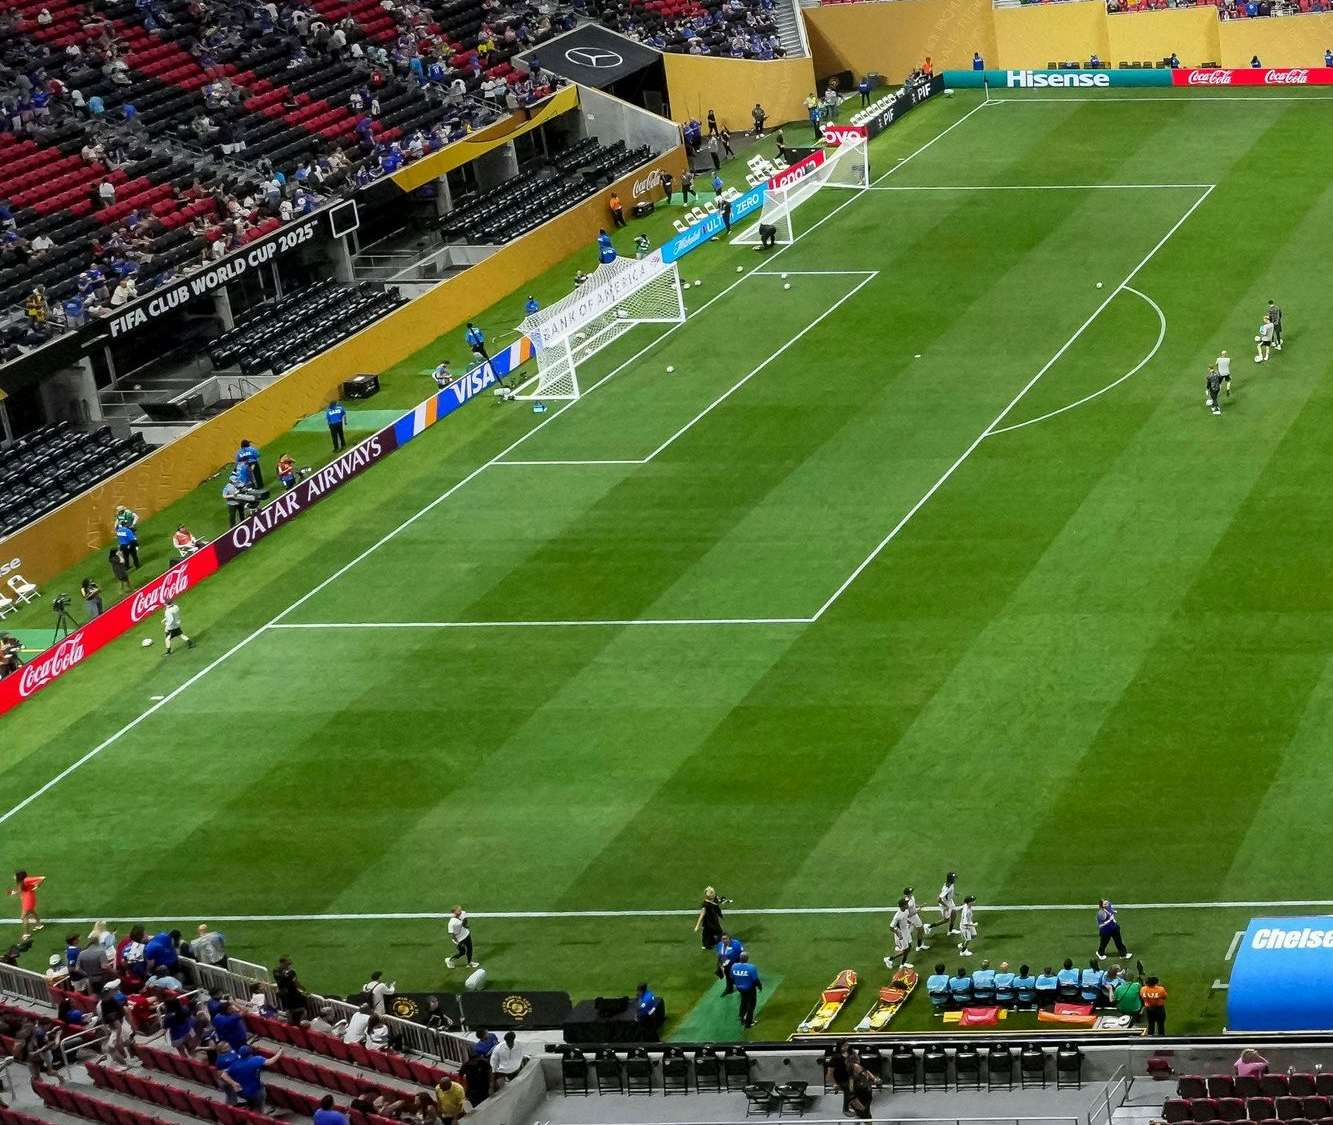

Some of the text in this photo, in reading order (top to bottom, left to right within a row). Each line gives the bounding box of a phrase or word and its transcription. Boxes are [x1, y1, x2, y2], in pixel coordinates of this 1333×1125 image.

[1006, 70, 1110, 88] Hisense
[1188, 69, 1232, 86] Coca-Cola
[1264, 69, 1310, 86] Coca-Cola
[917, 82, 931, 100] PIF
[883, 108, 895, 126] PIF
[736, 192, 760, 213] ZERO
[110, 304, 147, 339] FIFA
[149, 284, 189, 317] CLUB
[190, 256, 246, 302] WORLD
[248, 239, 277, 270] CUP
[449, 362, 497, 403] VISA
[231, 491, 382, 550] QATAR AIRWAYS
[131, 563, 189, 623] Coca-Cola
[18, 633, 84, 697] Coca-Cola
